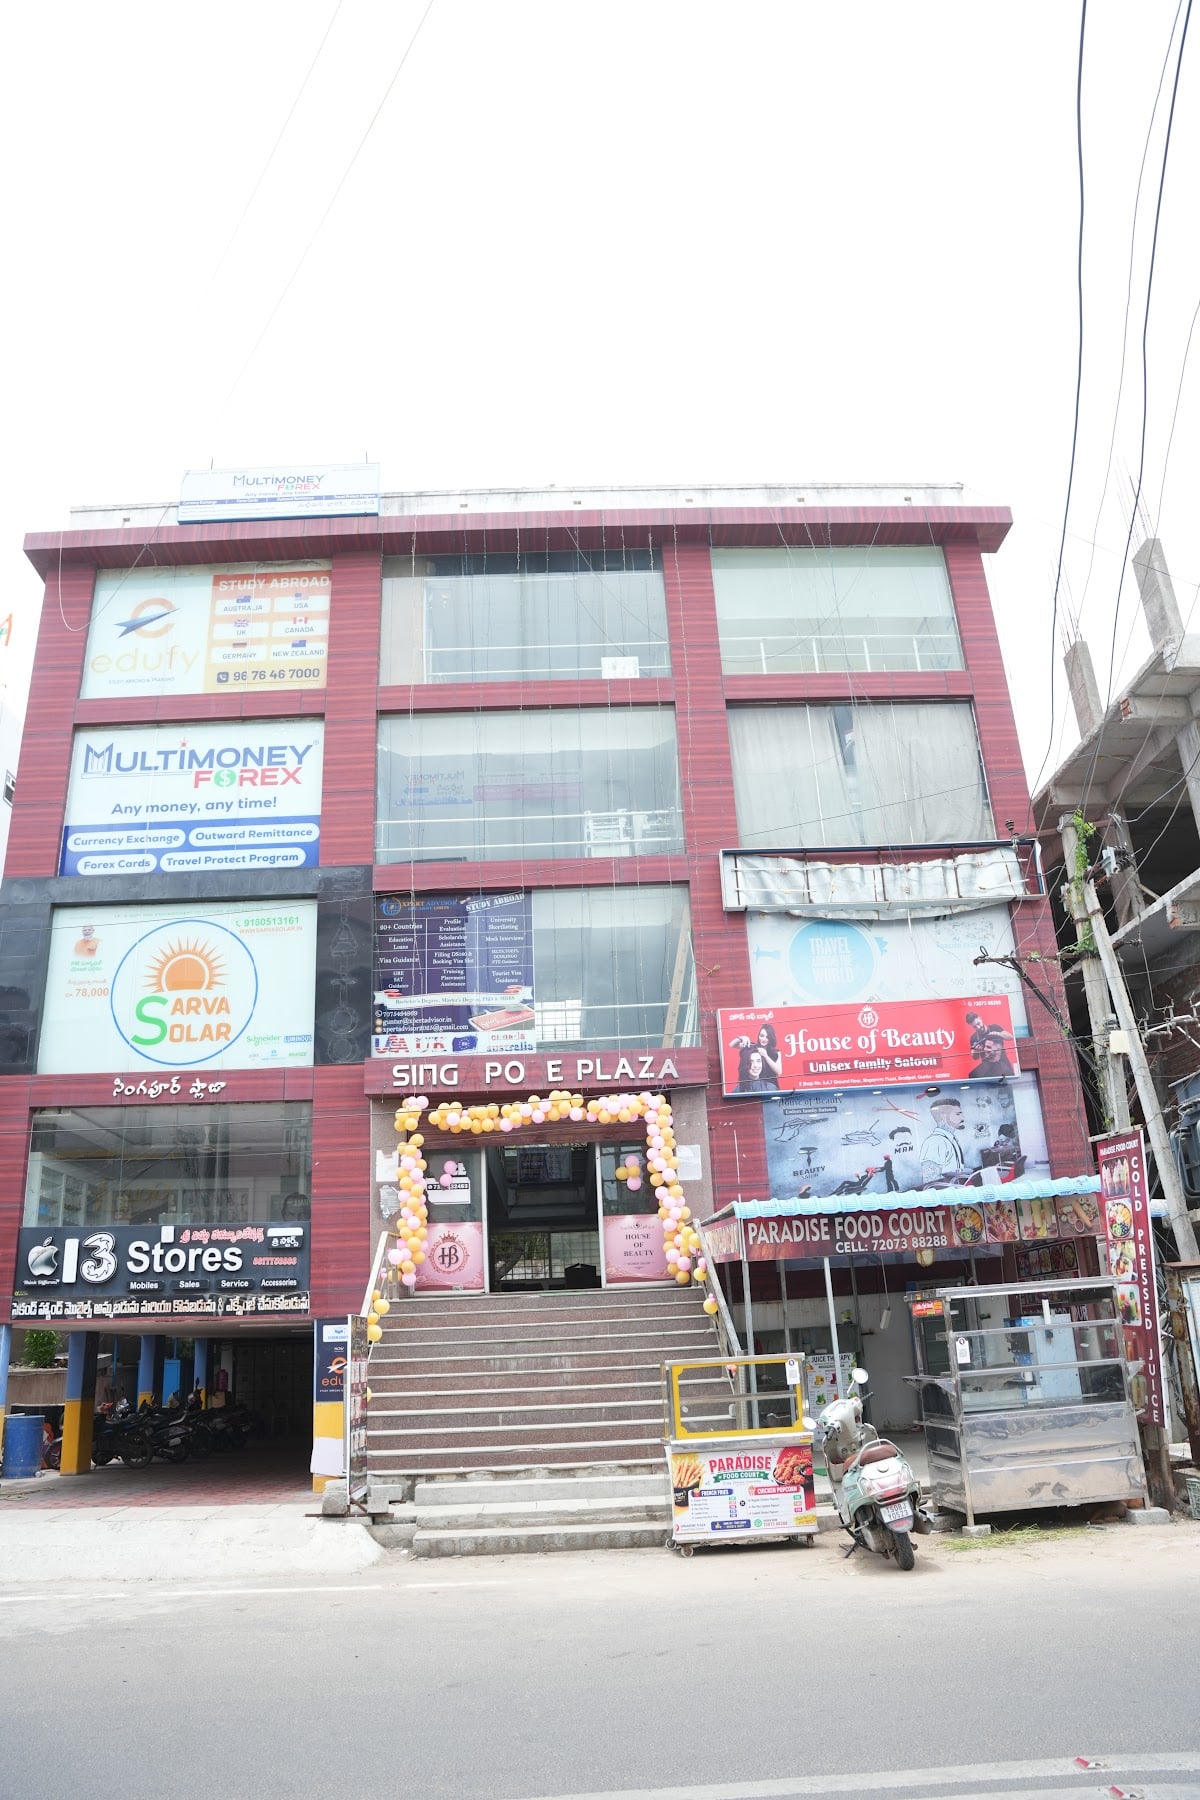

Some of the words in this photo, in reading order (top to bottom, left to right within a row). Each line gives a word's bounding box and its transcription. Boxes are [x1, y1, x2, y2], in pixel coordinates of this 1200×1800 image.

[233, 474, 326, 487] MULTIMONEY
[218, 578, 266, 592] STUDY
[270, 576, 330, 589] ABROAD
[285, 626, 314, 634] CANADA
[90, 643, 200, 674] edufy
[222, 652, 256, 660] GERMANY
[252, 670, 266, 680] 76
[270, 669, 285, 679] 46
[288, 668, 320, 678] 7000
[83, 741, 313, 773] MULTIMONEY
[194, 766, 302, 788] FOREX
[112, 803, 142, 816] Any
[146, 800, 200, 814] money,
[205, 799, 234, 812] any
[238, 796, 277, 808] time!
[74, 836, 124, 847] Currency
[126, 833, 180, 846] Exchange
[196, 830, 246, 840] Outward
[248, 828, 313, 839] Remittance
[84, 860, 115, 870] Forex
[118, 858, 151, 868] Cards
[166, 856, 200, 866] Travel
[204, 854, 246, 864] Protect
[250, 853, 299, 864] Program
[466, 899, 493, 912] STUDY
[493, 894, 525, 906] ABROAD
[809, 936, 852, 955] TRAVEL
[812, 967, 854, 984] WORLD
[374, 1036, 409, 1053] USA
[784, 1030, 852, 1057] House
[857, 1030, 879, 1054] of
[880, 1027, 955, 1049] Beauty
[392, 1064, 459, 1087] SING
[577, 1056, 680, 1082] PLAZA
[809, 1061, 851, 1073] Unisex
[854, 1058, 892, 1072] family
[894, 1055, 936, 1068] Saloon
[894, 1146, 914, 1154] MAN
[1116, 1143, 1126, 1152] FOOD
[793, 1166, 826, 1177] BEAUTY
[748, 1217, 831, 1245] PARADISE
[834, 1214, 884, 1240] FOOD
[888, 1209, 947, 1235] COURT
[835, 1240, 869, 1254] CELL:
[872, 1237, 909, 1251] 72073
[911, 1234, 948, 1248] 88288
[126, 1240, 243, 1273] Stores
[624, 1249, 654, 1257] BEAUTY
[130, 1280, 158, 1289] Mobiles
[179, 1280, 200, 1288] Sales
[221, 1279, 249, 1288] Service
[261, 1278, 297, 1287] Accessories
[1130, 1156, 1142, 1212] COLD
[1137, 1229, 1152, 1330] PRESSED
[1148, 1348, 1159, 1423] JUICE
[217, 1297, 224, 1311] &
[708, 1456, 772, 1472] PARADISE
